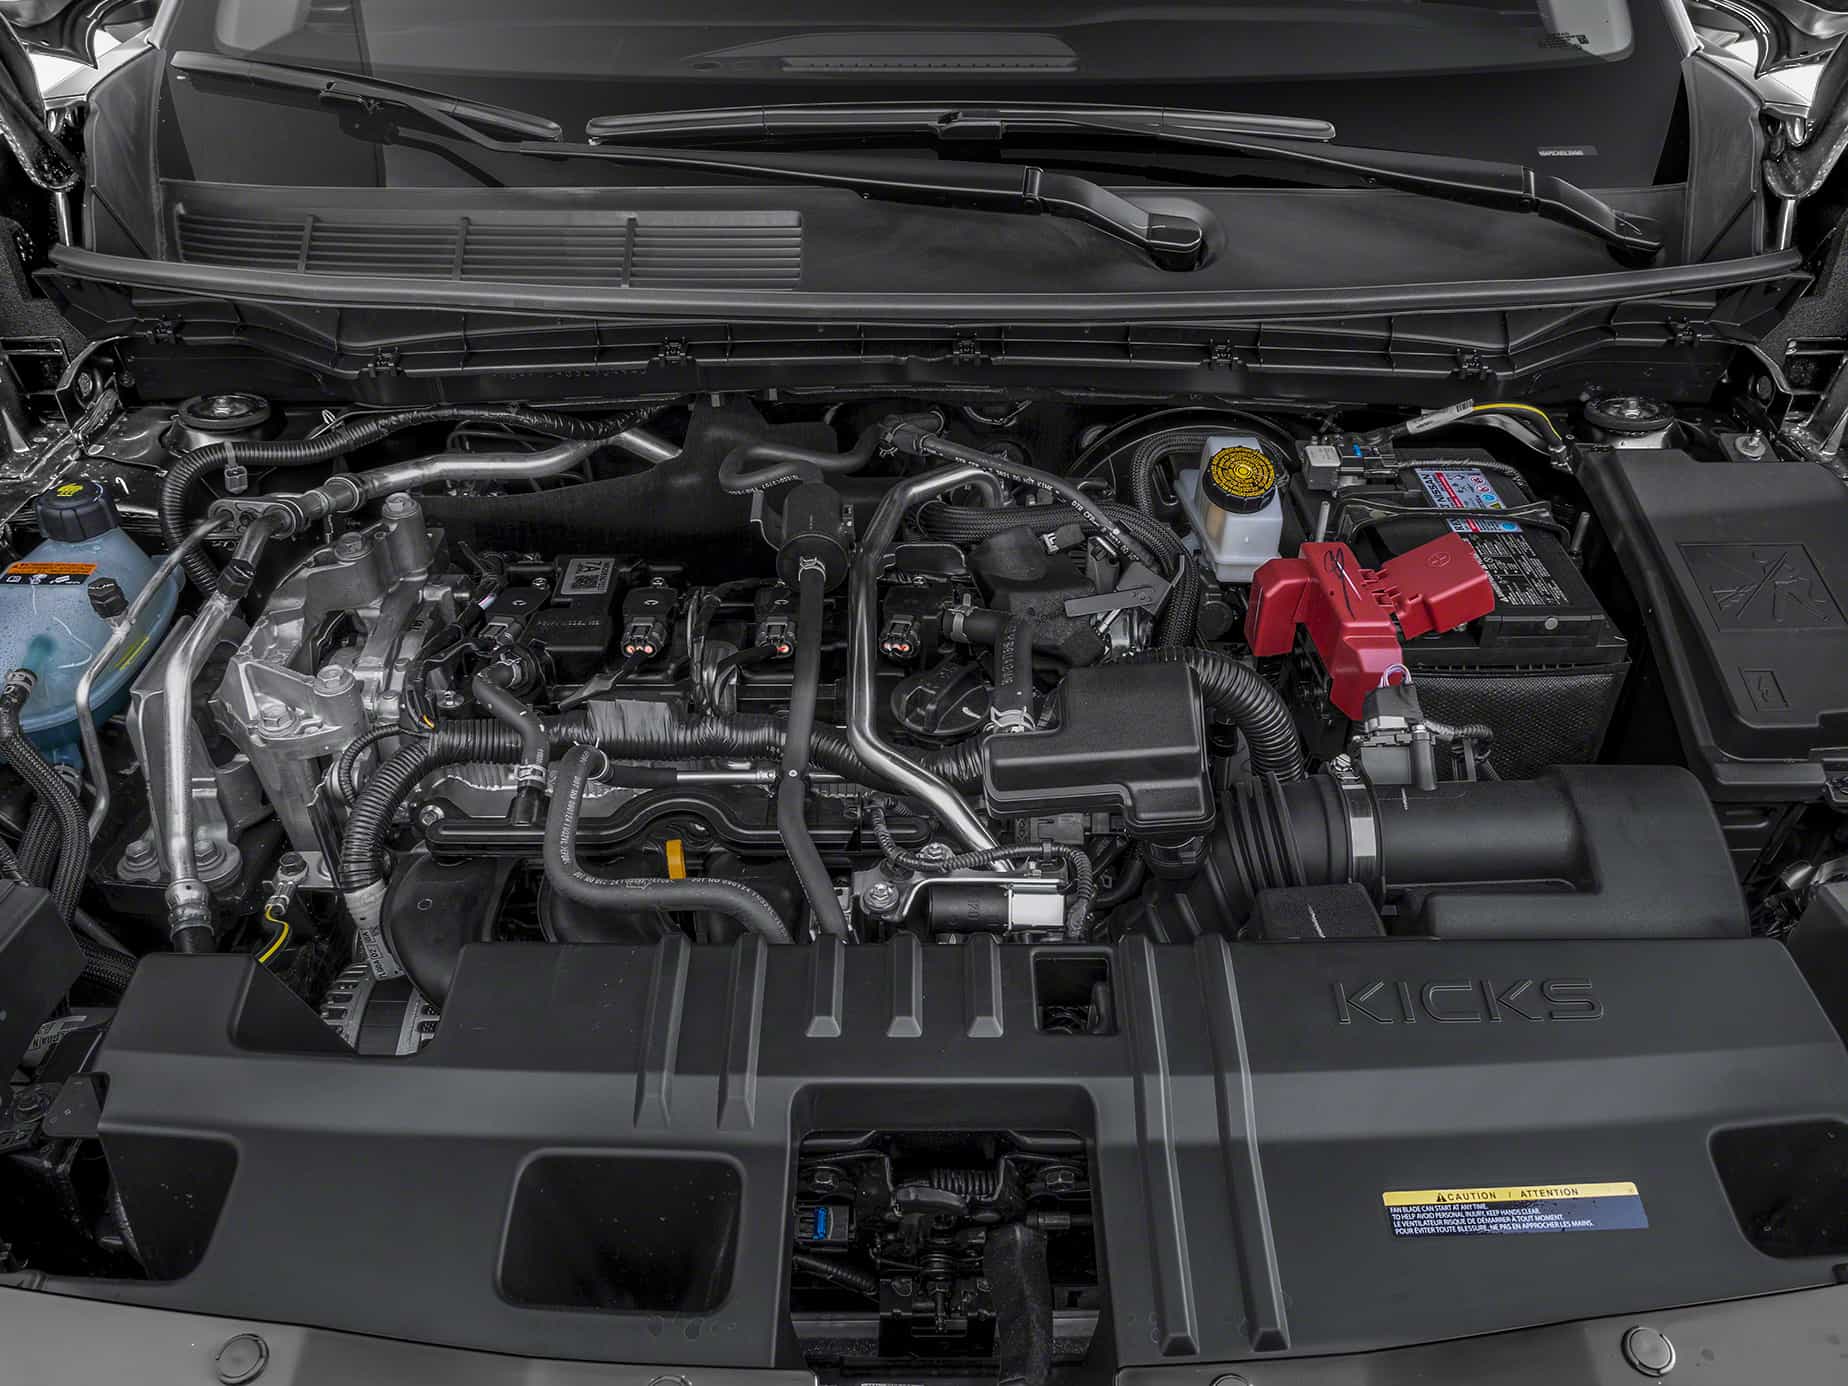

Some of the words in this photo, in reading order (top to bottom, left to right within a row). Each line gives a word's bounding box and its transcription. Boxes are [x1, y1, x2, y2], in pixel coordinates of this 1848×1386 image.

[1421, 473, 1446, 502] NISSAN
[1332, 979, 1605, 1024] KICKS
[1447, 1192, 1497, 1201] CAUTION
[1520, 1188, 1579, 1199] ATTENTION
[1486, 1209, 1500, 1217] KEEP
[1500, 1208, 1522, 1216] HANDS
[1394, 1227, 1414, 1235] POUR
[1414, 1225, 1436, 1234] ÉVITER
[1490, 1223, 1499, 1231] NE
[1499, 1223, 1512, 1231] PAS
[1512, 1222, 1522, 1230] EN
[1522, 1221, 1560, 1230] APPROCHER
[1560, 1220, 1571, 1228] LES
[1401, 1219, 1444, 1227] VENTILATEUR
[1443, 1218, 1467, 1226] RISQUE
[1477, 1215, 1512, 1224] DÉMARRER
[1517, 1215, 1535, 1223] TOUT
